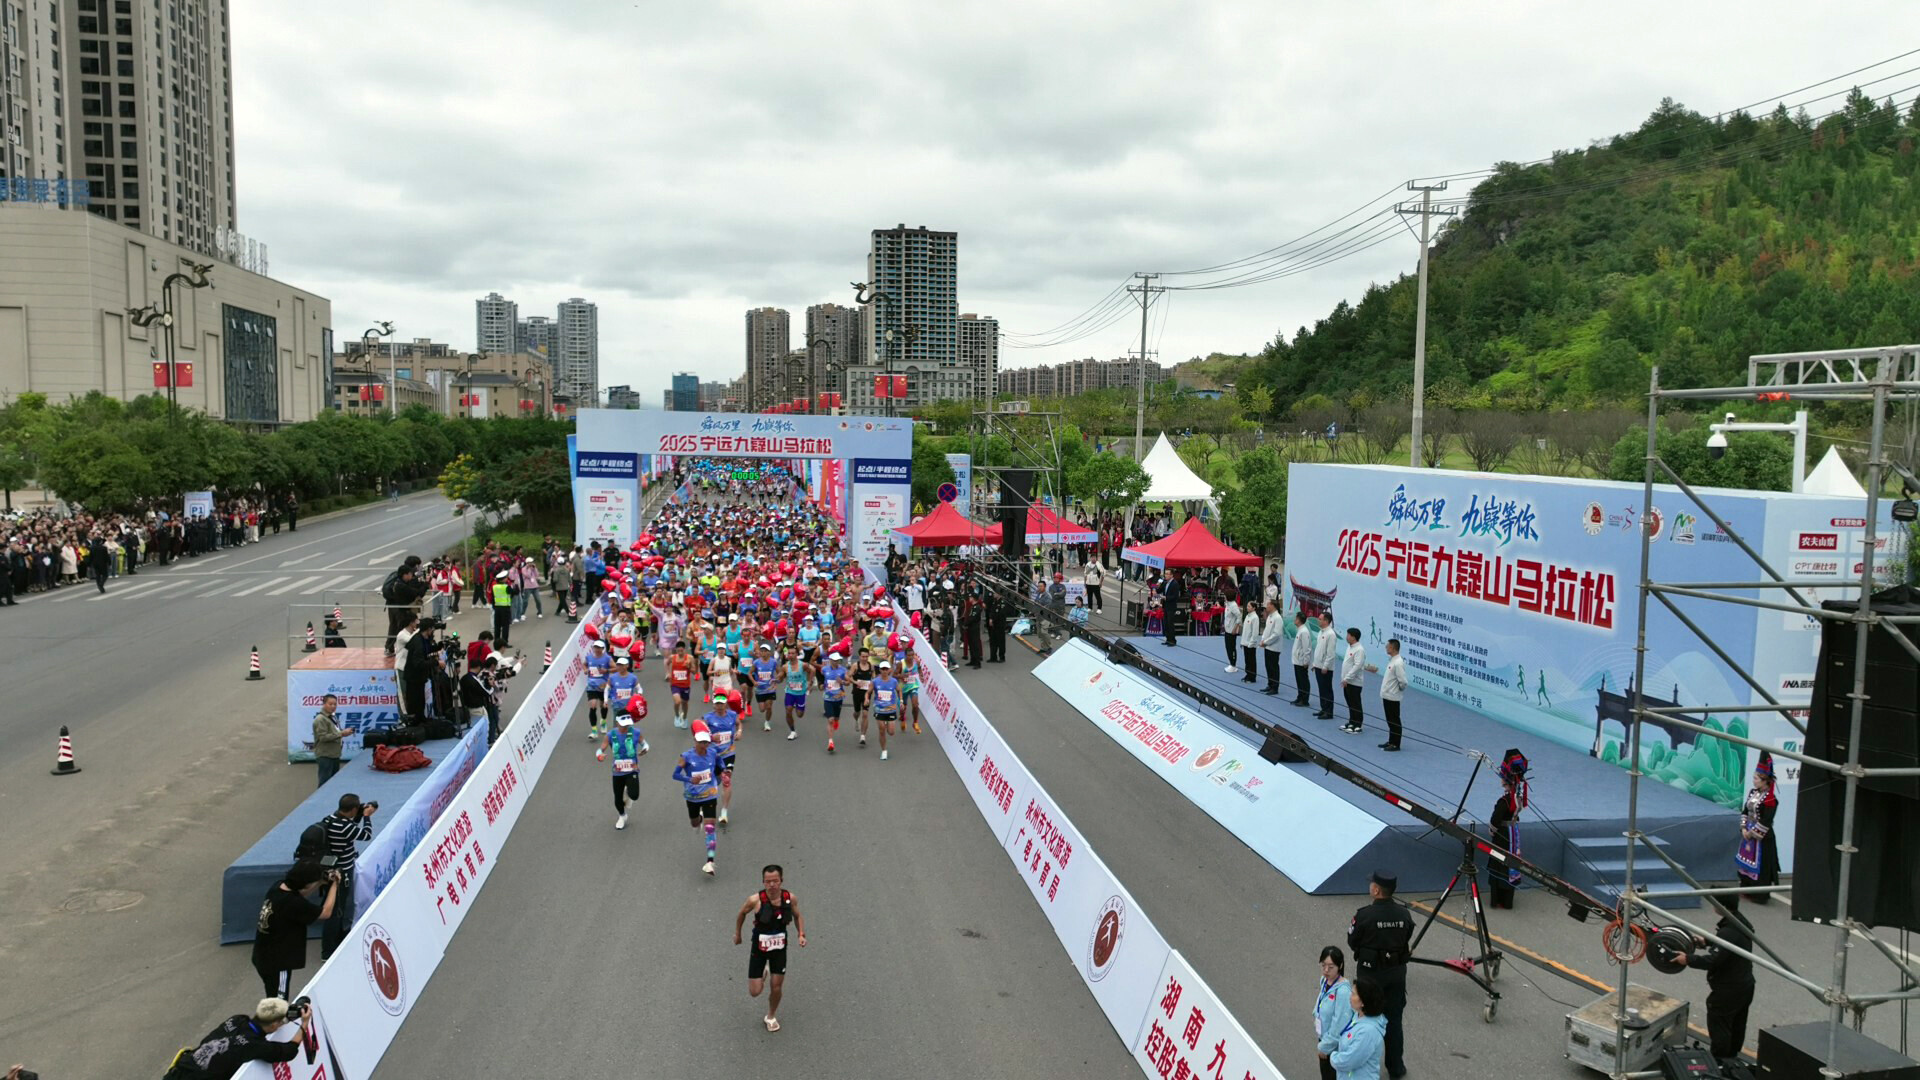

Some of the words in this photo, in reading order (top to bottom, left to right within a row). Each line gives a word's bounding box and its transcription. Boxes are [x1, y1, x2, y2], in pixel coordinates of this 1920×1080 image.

[1384, 483, 1450, 532] 舜风万里
[1801, 536, 1835, 547] 农夫山泉
[1336, 528, 1616, 630] 2025宁远九嶷山马拉松
[1413, 675, 1439, 692] 2025.10.19
[423, 810, 473, 889] 永州市文化旅游
[1014, 827, 1061, 903] 广电体育局
[1025, 798, 1073, 871] 永州市文化旅游
[436, 840, 485, 925] 广电体育局
